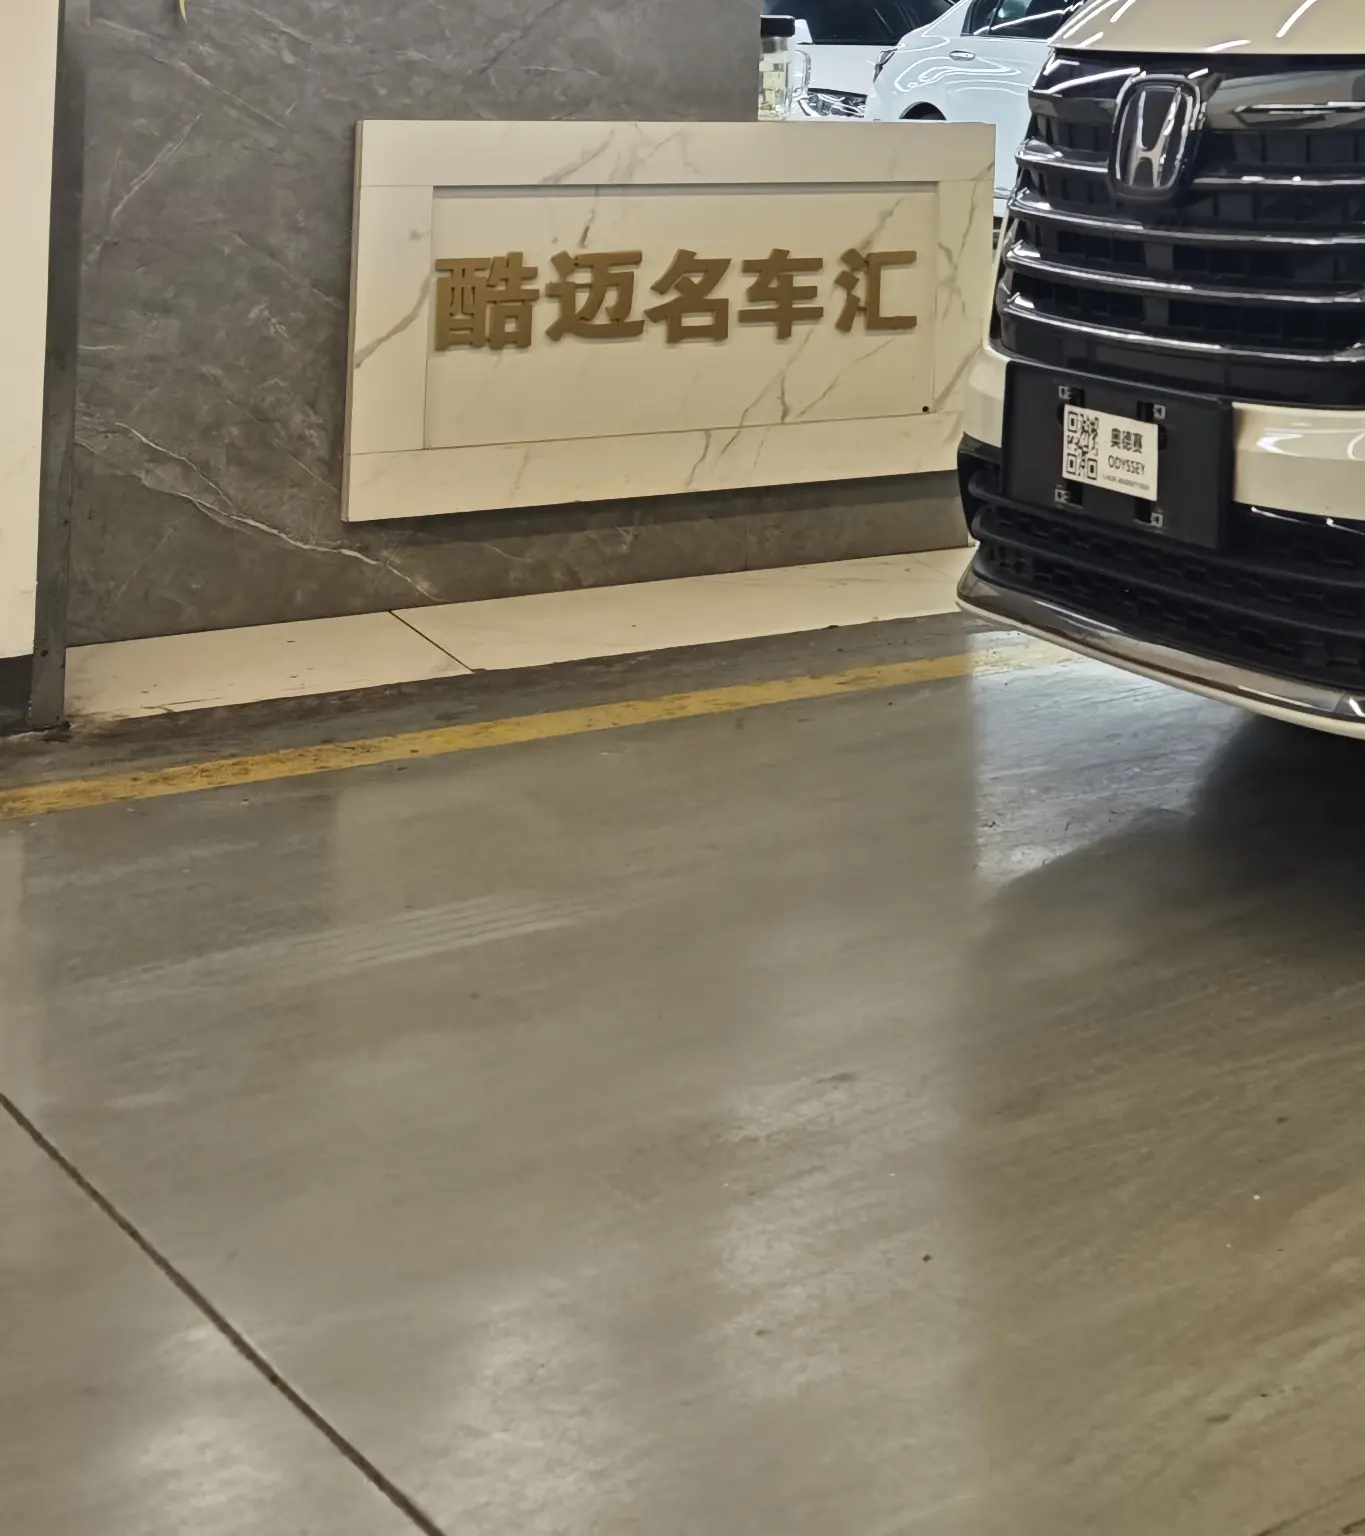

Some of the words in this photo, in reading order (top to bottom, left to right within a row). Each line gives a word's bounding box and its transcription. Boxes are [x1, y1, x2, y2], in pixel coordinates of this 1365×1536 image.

[434, 249, 918, 351] 酷迈名车汇
[1108, 454, 1146, 475] ODYSSEY
